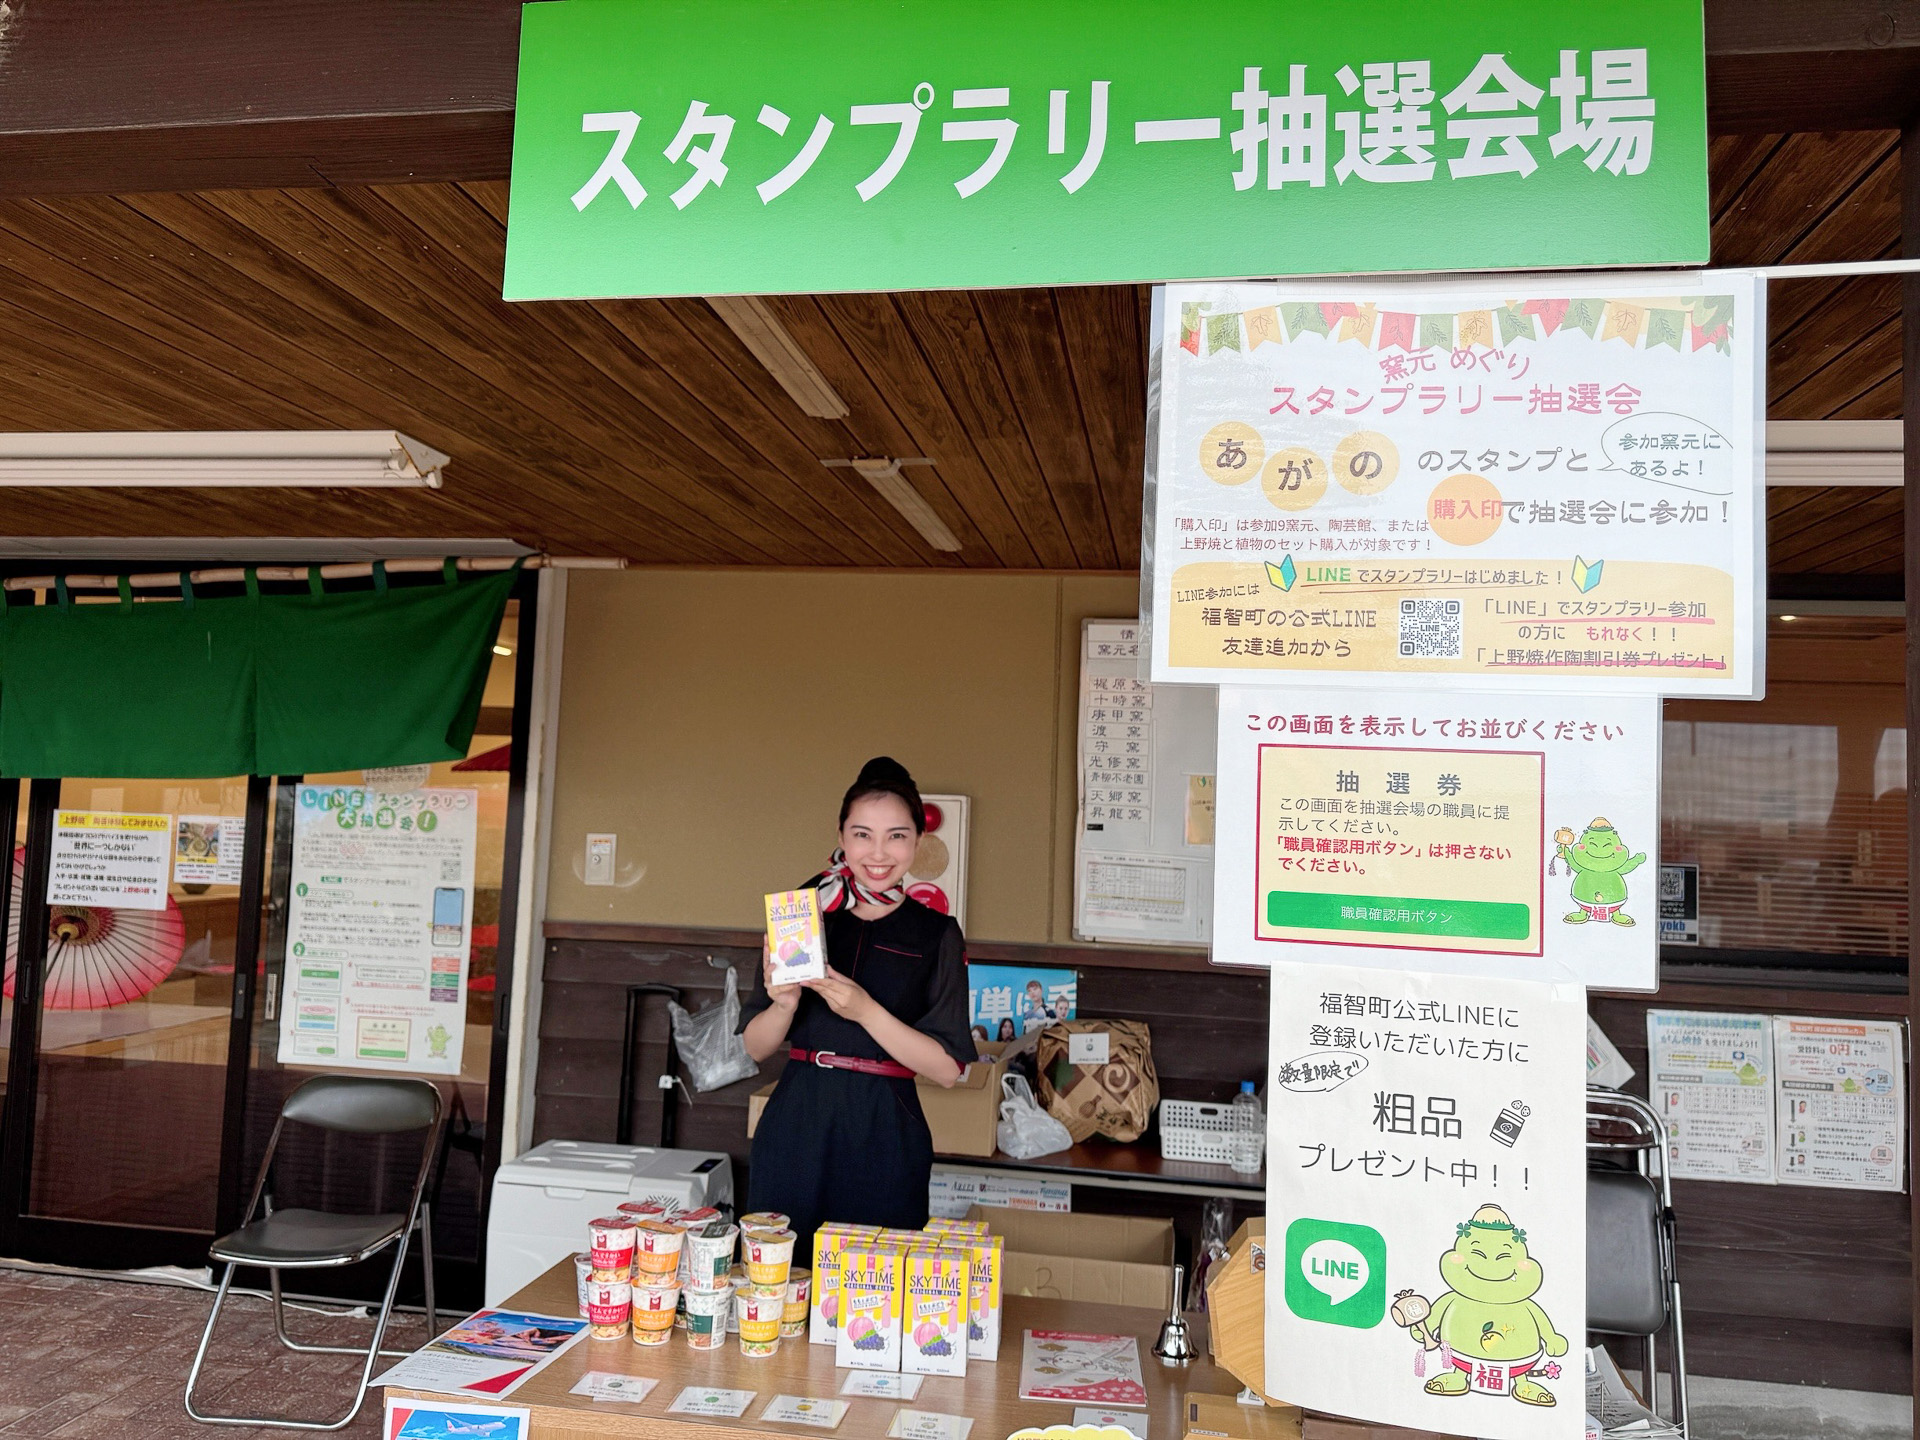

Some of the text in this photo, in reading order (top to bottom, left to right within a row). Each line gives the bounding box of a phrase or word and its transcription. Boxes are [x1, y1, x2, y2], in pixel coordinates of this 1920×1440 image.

[570, 47, 1656, 212] スタンプラリー抽選会場
[1269, 383, 1642, 416] スタンプラリー抽選会
[1618, 432, 1721, 452] 参加窯元に
[1216, 438, 1588, 492] あ が の のスタンプと
[1630, 459, 1705, 477] あるよ！
[1175, 518, 1430, 535] 「購入印」は参加9窯元、陶芸館、または
[1180, 537, 1431, 553] 上野焼と植物のセット購入が対象です！
[1306, 566, 1562, 586] LINE でスタンプラリーはじめました！
[1178, 584, 1260, 602] LINE参加には
[1202, 608, 1376, 628] 福智町の公式LINE
[1486, 598, 1706, 619] 「LINE」でスタンプラリー参加
[1420, 624, 1439, 632] LINE
[1518, 624, 1678, 642] の方に もれなく！！
[1222, 638, 1352, 658] 友達追加から
[1478, 648, 1726, 670] 「上野焼作陶割引券プレゼント」
[1246, 713, 1624, 741] この画面を表示してお並びください
[378, 792, 469, 809] スタンプラリー
[1280, 797, 1510, 820] この画面を抽選会場の職員に提
[1279, 818, 1399, 836] 示してください。
[1276, 837, 1512, 860] 「職員確認用ボタン」は押さない
[1279, 858, 1366, 875] でください。
[1341, 906, 1453, 924] 職員確認用ボタン
[1592, 906, 1608, 921] 福
[1319, 992, 1519, 1028] 福智町公式LINEに
[1310, 1025, 1529, 1063] 登録いただいた方に
[1281, 1060, 1359, 1084] 数量限定で
[1373, 1090, 1462, 1139] 粗品
[1299, 1144, 1529, 1190] プレゼント中！！
[1312, 1257, 1359, 1280] LINE
[1475, 1363, 1503, 1391] 福
